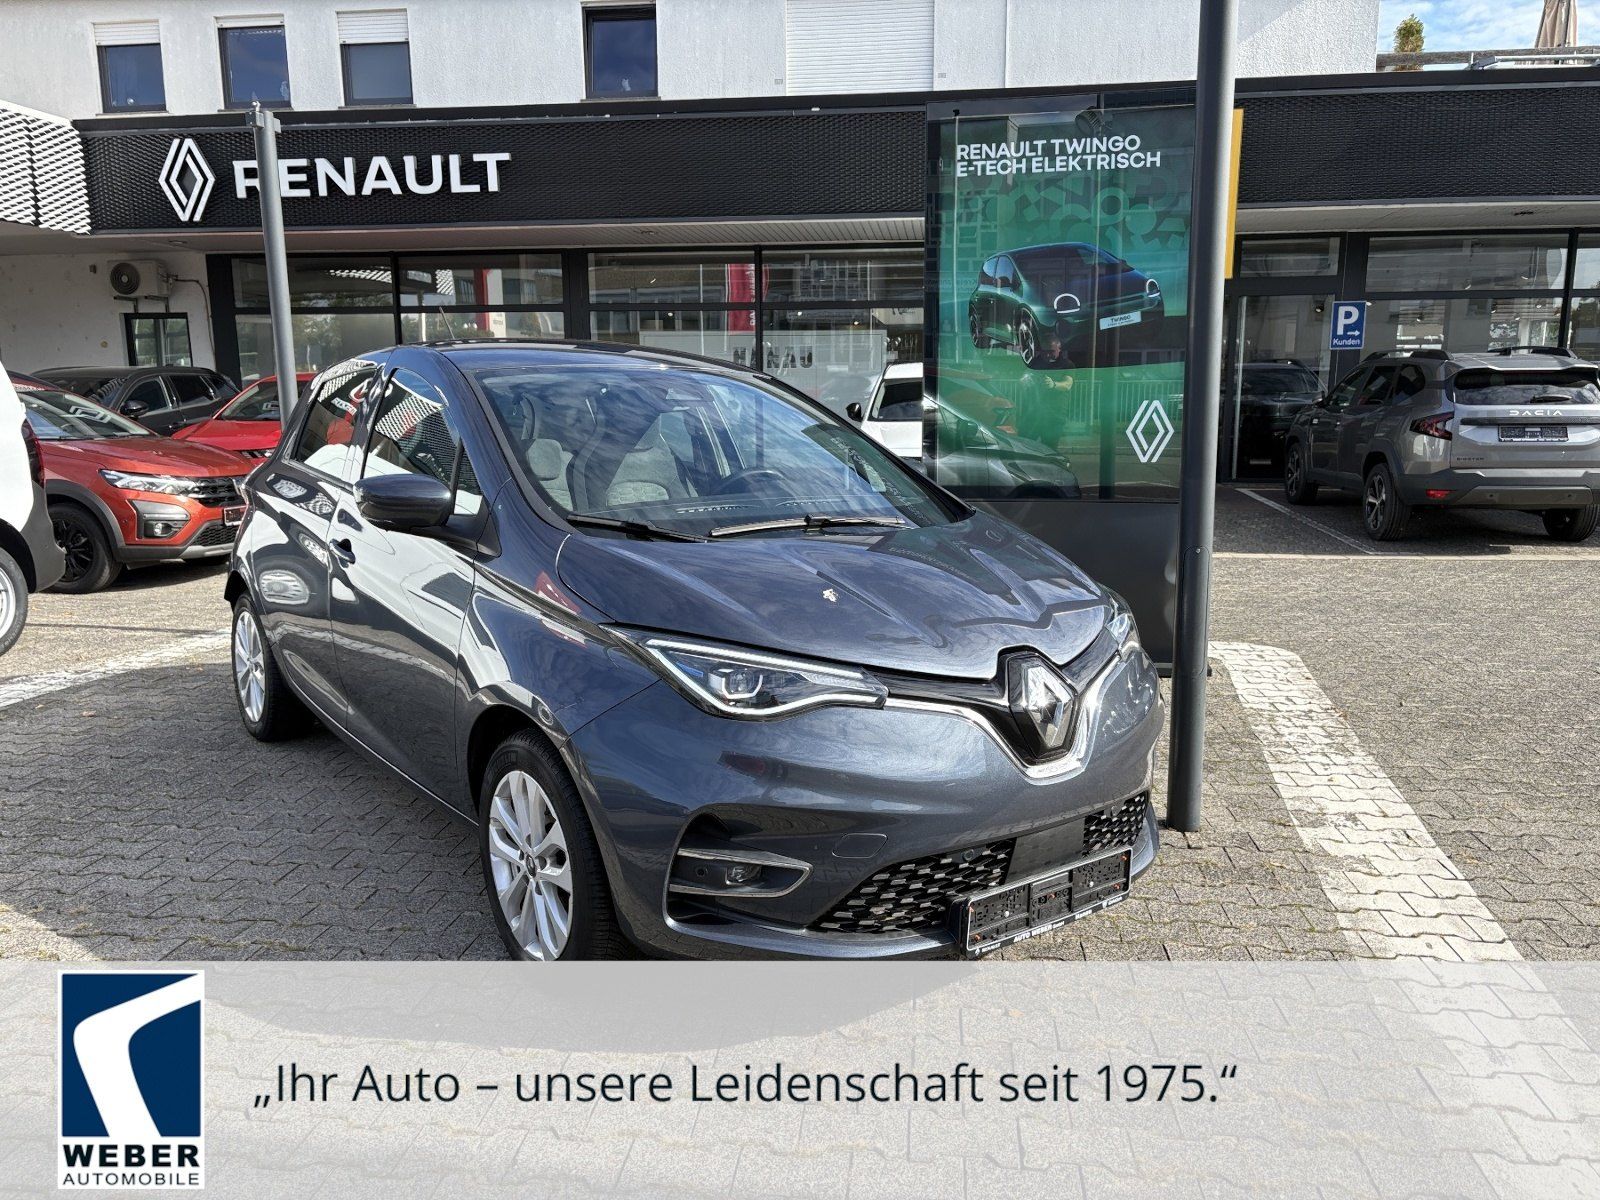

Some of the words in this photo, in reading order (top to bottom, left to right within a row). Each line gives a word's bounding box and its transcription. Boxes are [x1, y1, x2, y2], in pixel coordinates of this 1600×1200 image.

[956, 140, 1046, 160] RENAULT
[1050, 135, 1141, 155] TWINGO
[232, 152, 511, 199] RENAULT
[956, 158, 1026, 177] E-TECH
[1031, 151, 1161, 173] ELEKTRISCH
[1336, 305, 1359, 336] P
[1333, 338, 1360, 346] Kunden
